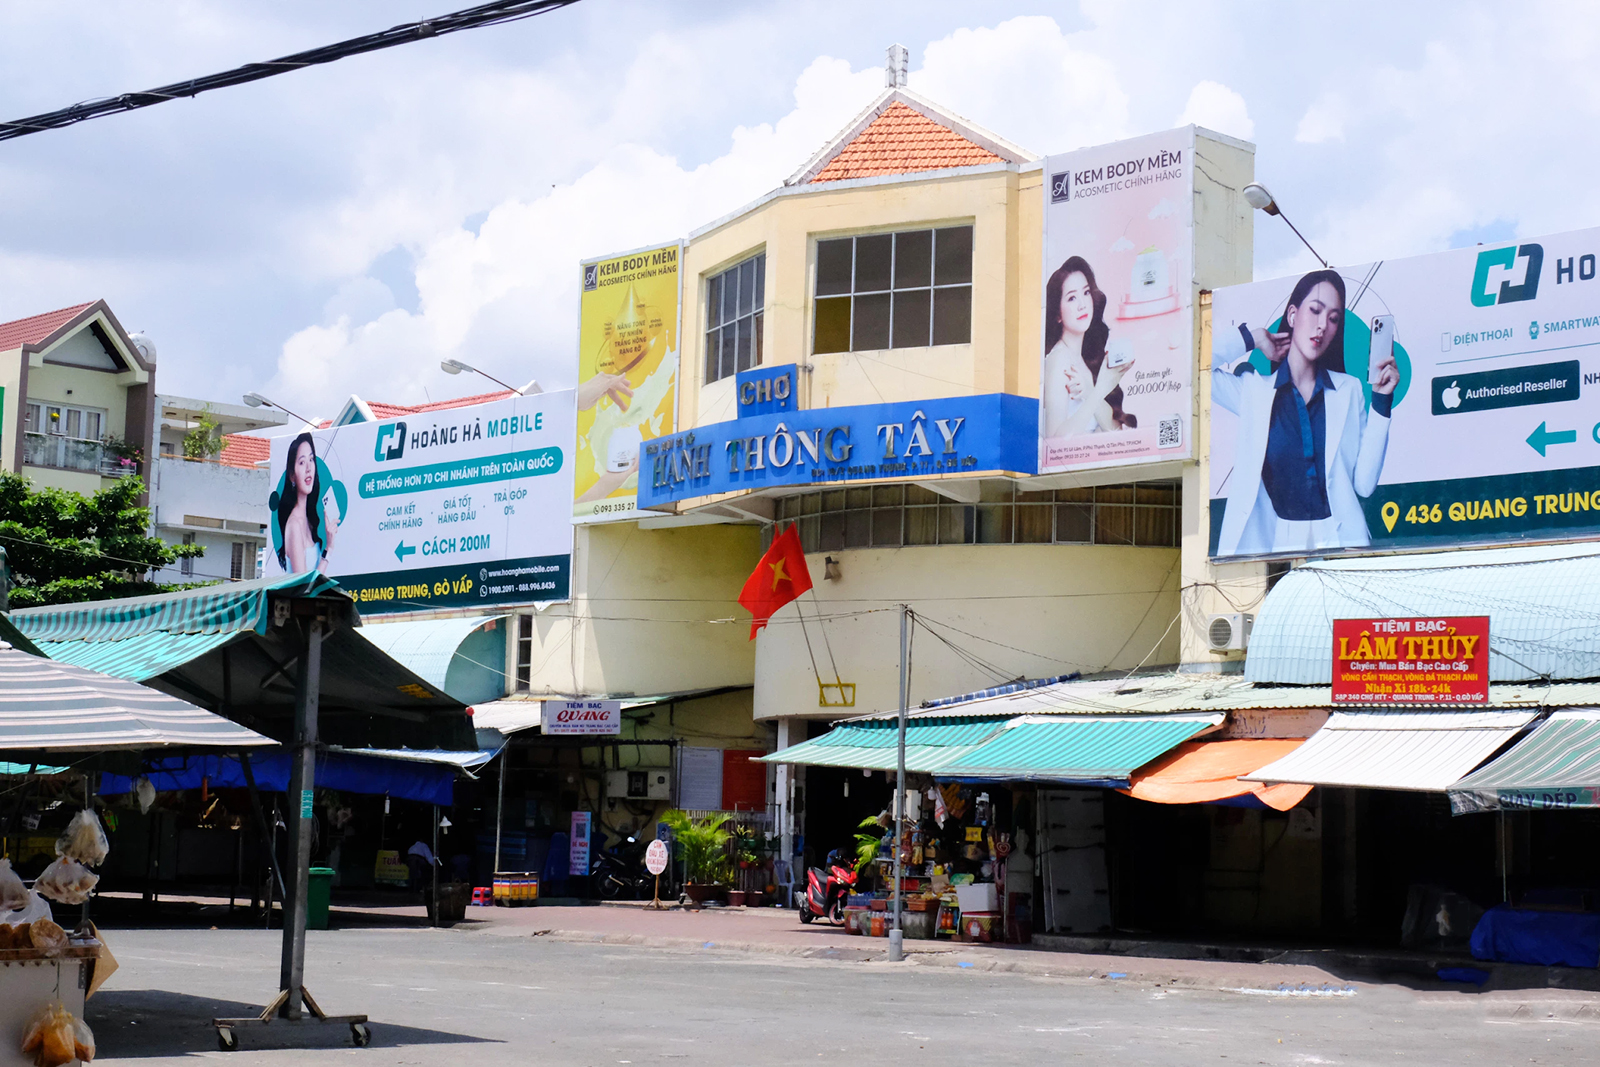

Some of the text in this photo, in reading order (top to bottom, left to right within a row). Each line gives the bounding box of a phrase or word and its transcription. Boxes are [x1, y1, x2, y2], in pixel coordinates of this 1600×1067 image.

[1074, 149, 1182, 186] KEM BODY MỀM
[1074, 168, 1182, 200] ACOSMETIC CHÍNH HÃNG
[599, 248, 677, 277] KEM BODY MỀM
[1557, 253, 1596, 285] HO
[598, 265, 677, 288] ACOSMETICS CHÍNH HÃNG
[1543, 315, 1600, 334] SMARTWA
[1453, 327, 1513, 347] ĐIỆN THOẠI
[739, 372, 791, 407] CHỢ
[1465, 377, 1568, 400] Authorised Reseller
[411, 412, 543, 450] HOÀNG HÀ MOBILE
[652, 442, 712, 492] HẠNH
[725, 422, 854, 474] THÔNG
[877, 409, 965, 459] TÂY
[365, 452, 554, 493] HỆ THỐNG HƠN 70 CHI NHÁNH TRÊN TOÀN QUỐC
[443, 496, 472, 510] GIÁ TỐT
[493, 489, 528, 504] TRẢ GÓP
[386, 501, 416, 517] CAM KẾT
[437, 511, 459, 525] HÀNG
[600, 504, 612, 513] 093
[613, 503, 626, 511] 335
[1405, 503, 1443, 524] 436
[1448, 496, 1528, 522] QUANG
[378, 517, 423, 531] CHÍNH HÃNG
[422, 534, 491, 556] CÁCH 200M
[488, 564, 560, 579] www.hoanghamobile.com
[360, 585, 394, 603] QUANG
[397, 581, 432, 600] TRUNG,
[433, 578, 450, 596] GÒ
[452, 573, 473, 595] VẤP
[1372, 619, 1447, 634] TIỆM BẠC
[1338, 626, 1480, 660] LÂM THỦY
[1379, 662, 1396, 671] Mua
[1398, 661, 1415, 671] Bán
[1416, 661, 1433, 673] Bạc
[1434, 661, 1451, 671] Cao
[1452, 660, 1469, 672] Cấp
[1341, 673, 1360, 682] VÒNG
[1405, 673, 1425, 682] VÒNG
[1425, 672, 1436, 682] ĐÁ
[1437, 673, 1462, 682] THẠCH
[1462, 673, 1478, 681] ANH
[1335, 693, 1348, 701] SẠP
[1349, 693, 1360, 701] 340
[1360, 693, 1374, 701] CHỢ
[1471, 691, 1484, 701] VẤP
[1365, 683, 1393, 695] Nhận
[1394, 683, 1406, 693] Xi
[556, 709, 611, 723] QUANG
[566, 702, 602, 710] TIỆM BẠC
[1542, 788, 1578, 809] DÉP
